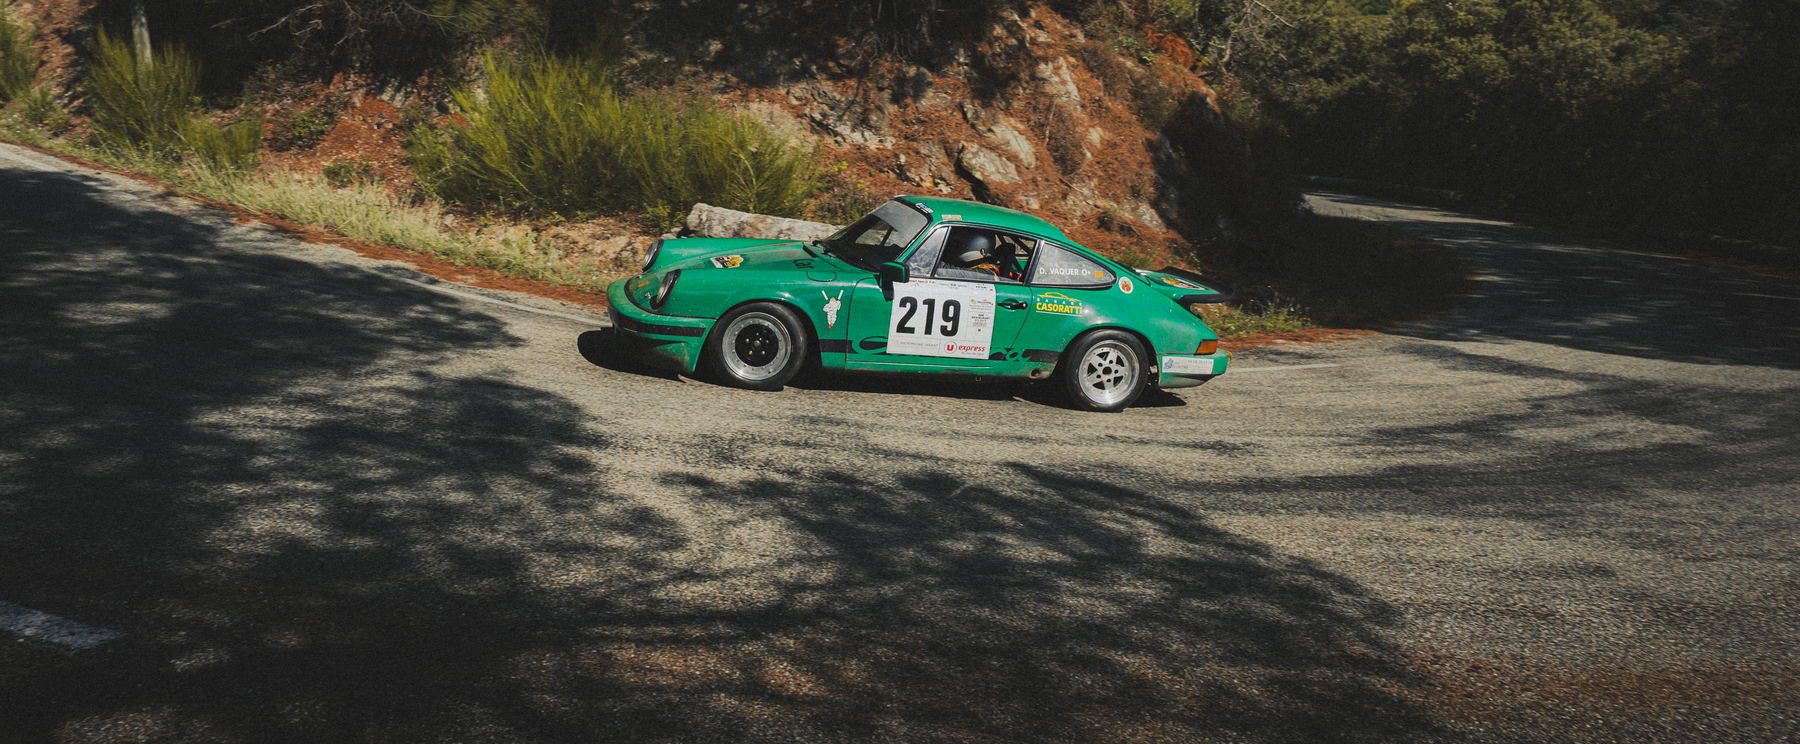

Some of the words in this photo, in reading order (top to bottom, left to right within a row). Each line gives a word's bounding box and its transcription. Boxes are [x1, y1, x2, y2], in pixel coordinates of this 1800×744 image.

[1050, 267, 1079, 276] VAQUER
[1036, 302, 1083, 314] CASORATTI
[896, 296, 961, 337] 219
[958, 344, 986, 352] express
